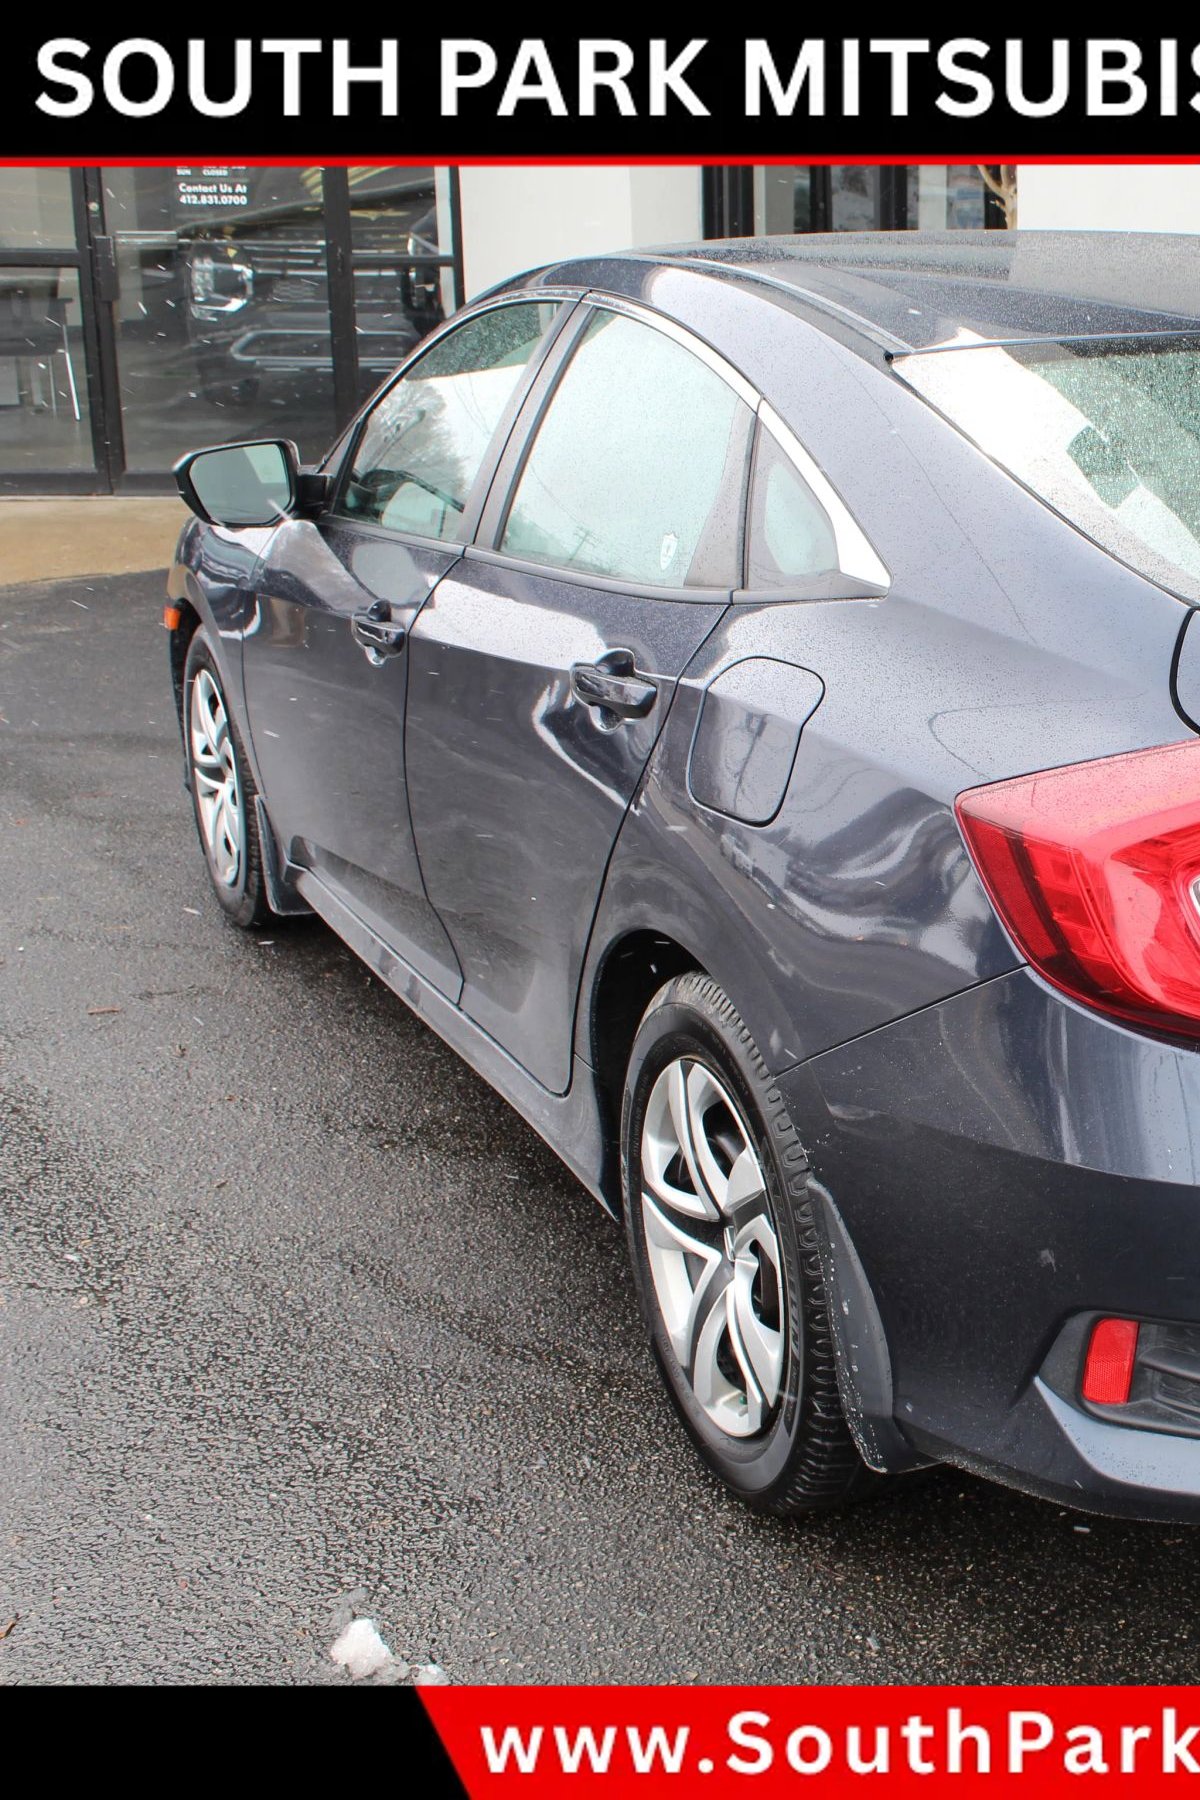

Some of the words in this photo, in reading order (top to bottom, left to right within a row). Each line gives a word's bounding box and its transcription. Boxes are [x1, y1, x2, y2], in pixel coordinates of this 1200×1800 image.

[179, 183, 217, 193] Contact
[219, 184, 233, 193] Us
[235, 184, 247, 193] At
[180, 194, 248, 205] 412.831.0700
